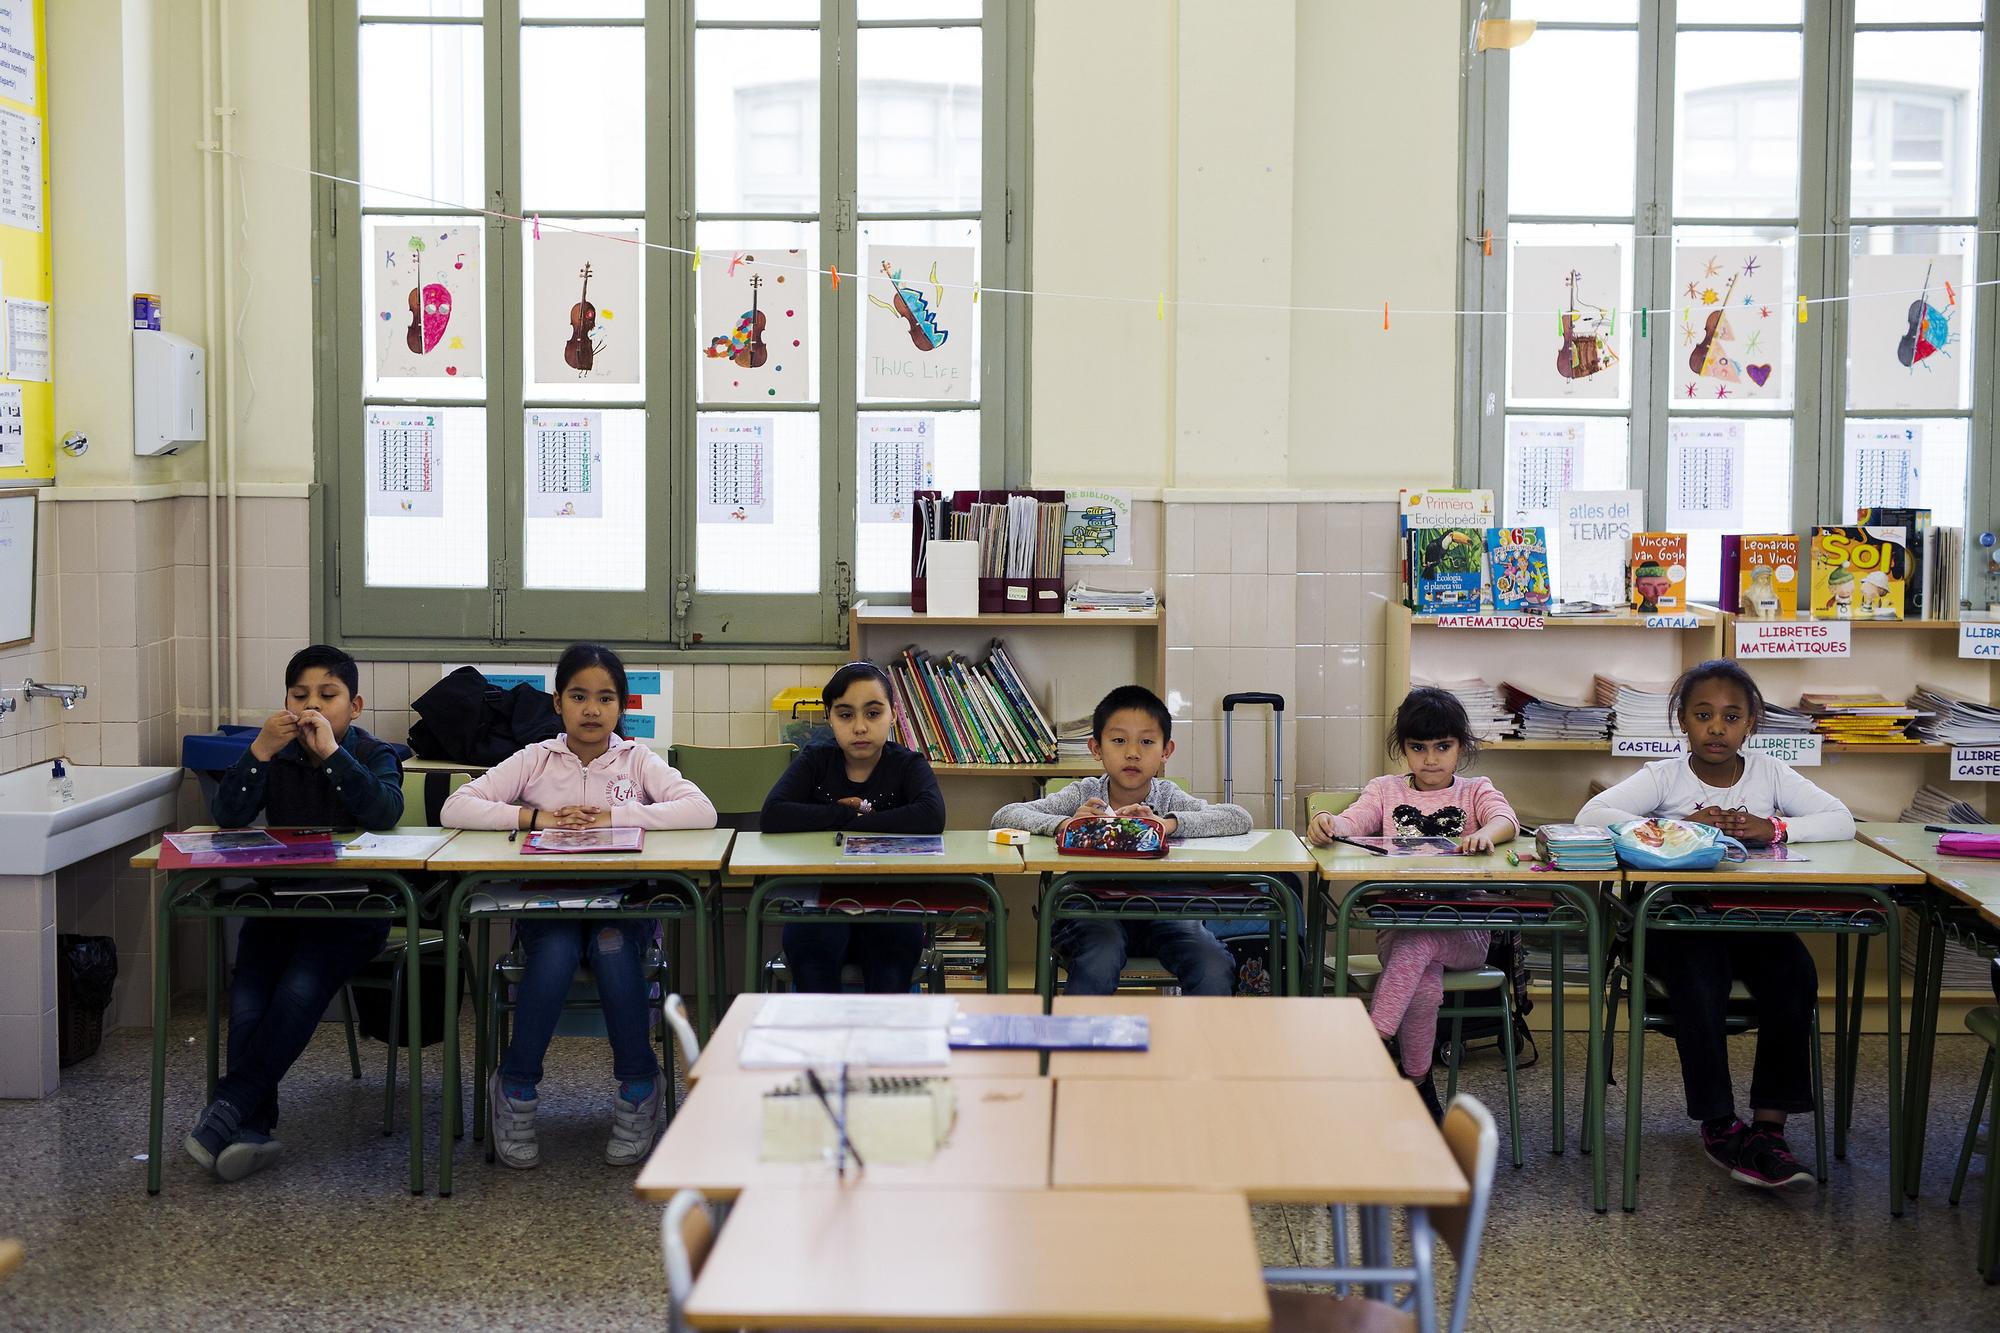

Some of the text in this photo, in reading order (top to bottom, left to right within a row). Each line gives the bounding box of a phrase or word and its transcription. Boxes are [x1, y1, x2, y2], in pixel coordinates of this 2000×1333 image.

[426, 416, 434, 426] 2
[918, 421, 926, 434] 8
[1568, 428, 1575, 440] 5
[1080, 491, 1128, 514] BIBLIOTECA
[1426, 496, 1474, 510] Primera
[1569, 502, 1629, 519] atles del
[1498, 528, 1537, 547] 365
[1569, 522, 1630, 540] TEMPS
[1640, 535, 1680, 547] Vincent
[1744, 537, 1795, 552] Leonardo
[1635, 548, 1685, 564] van Gogh
[1749, 550, 1797, 565] da Vinci
[1431, 582, 1451, 592] planeta
[1438, 616, 1544, 629] MATEMATIQUES
[1647, 617, 1697, 628] CATALA
[1759, 626, 1828, 637] LLIBRETES
[1966, 626, 2000, 638] LLIBR
[1740, 639, 1847, 654] MATEMÀTIQUES
[1974, 644, 2000, 655] CAT
[1618, 740, 1682, 753] CASTELLÀ
[1748, 737, 1816, 749] LLIBRETES
[1957, 750, 2000, 761] LLIBRE
[1958, 765, 2000, 776] CASTE
